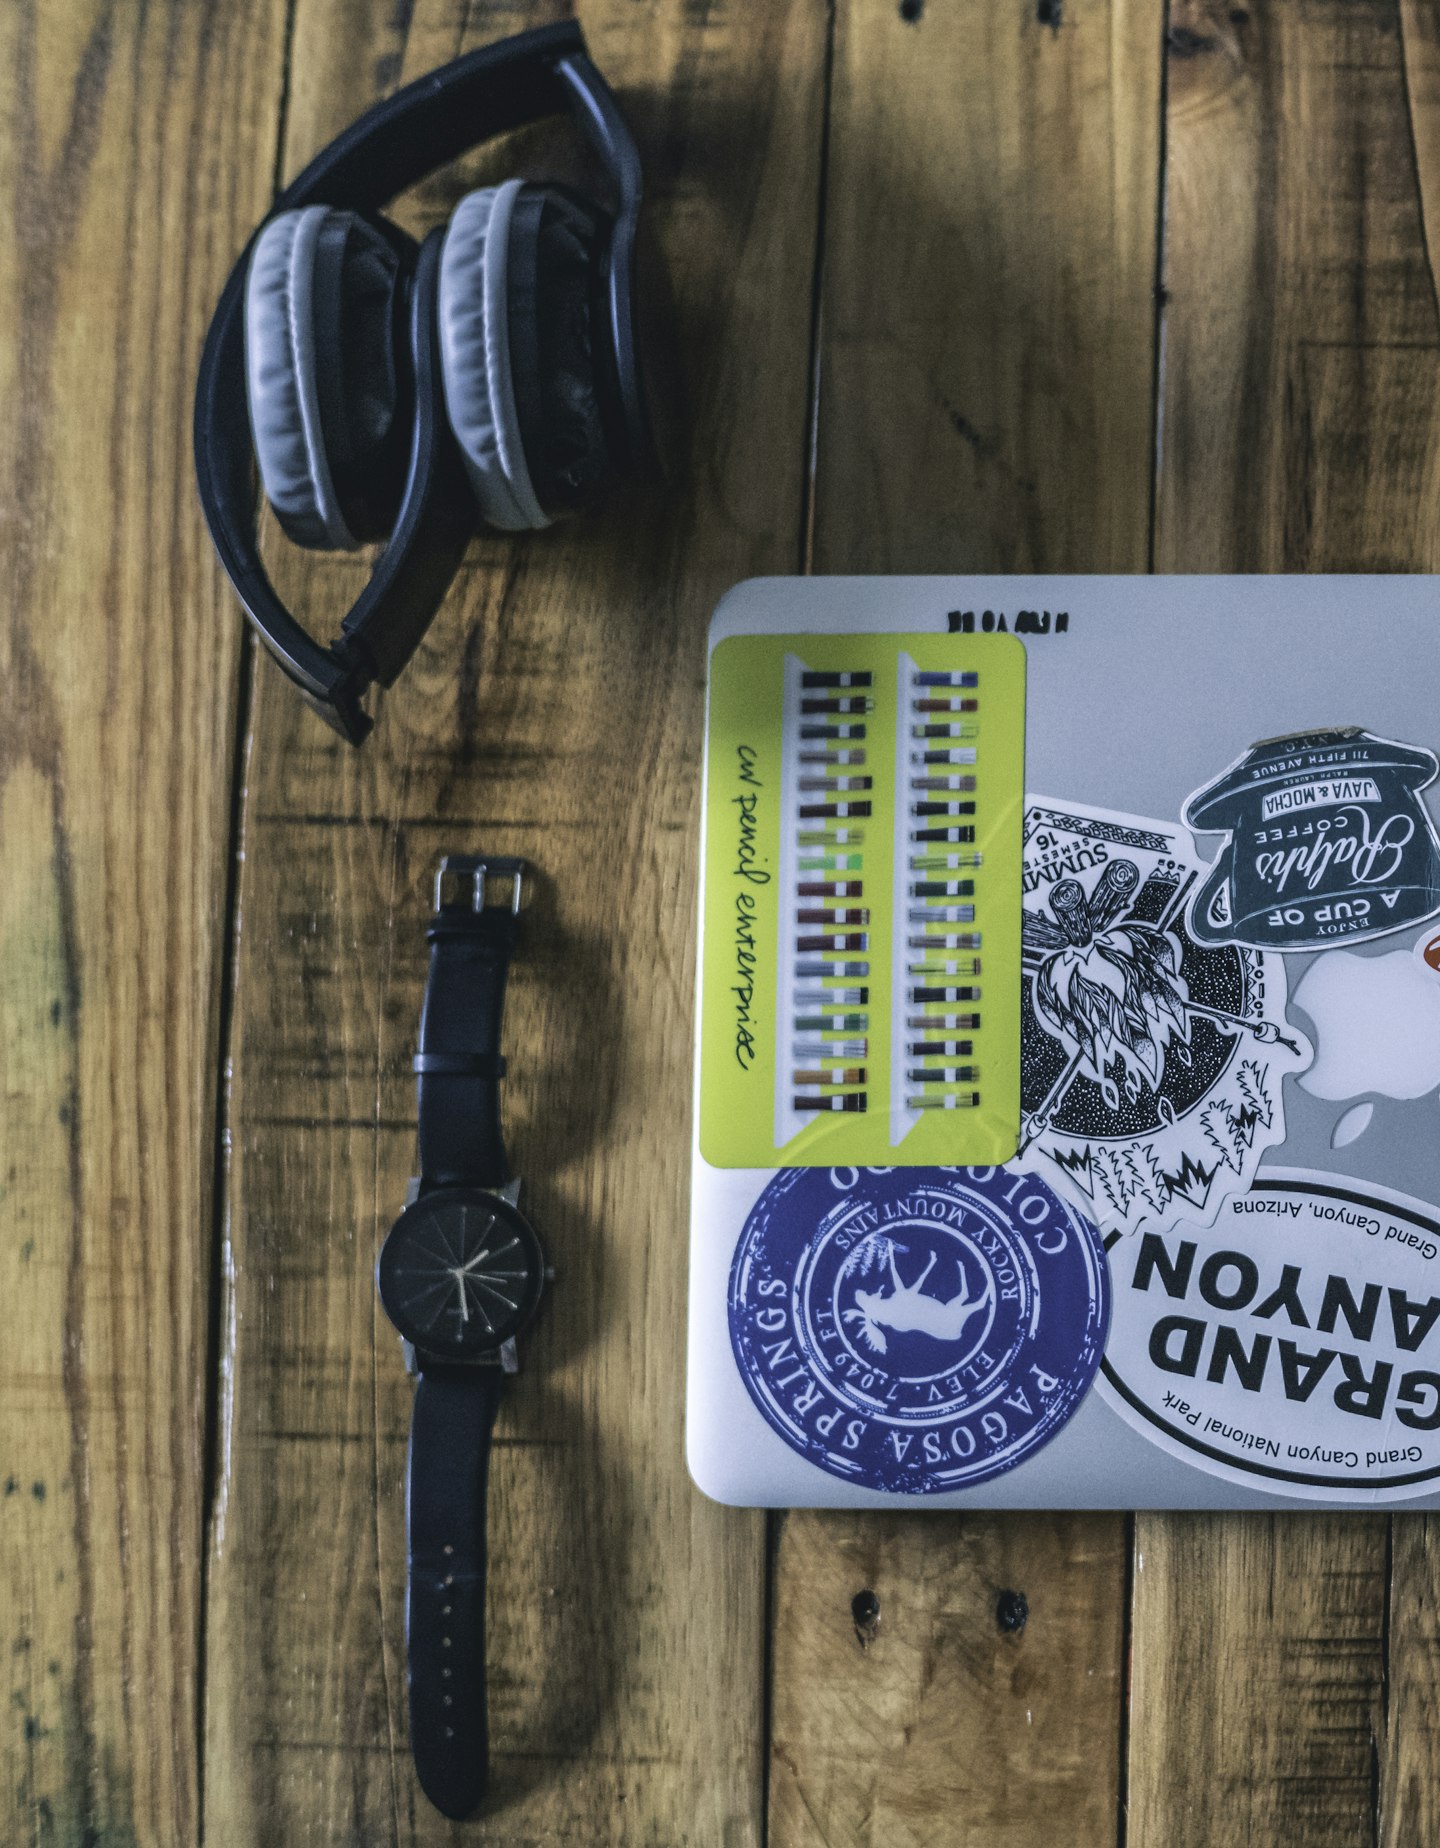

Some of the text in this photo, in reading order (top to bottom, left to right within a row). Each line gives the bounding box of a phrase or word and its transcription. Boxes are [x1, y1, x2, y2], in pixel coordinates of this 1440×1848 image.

[1252, 750, 1368, 779] 711 FIFTH AVENUE
[1282, 770, 1348, 786] RALPH LAUREN
[1265, 781, 1372, 814] JAVA & MOCHA
[731, 794, 771, 885] pencil
[1023, 838, 1089, 870] SEMESTE
[1036, 832, 1059, 850] 16
[1254, 816, 1348, 844] COFFEE
[1255, 805, 1415, 893] Ralph's
[1022, 843, 1108, 895] SUMMI
[1267, 890, 1401, 926] A CUP OF
[1316, 917, 1369, 935] ENJOY
[731, 892, 756, 1071] enterprise
[835, 1198, 1018, 1300] ROCKY MOUNTAINS
[1233, 1200, 1438, 1260] Grand Canyon, Arizona
[756, 1277, 1059, 1463] PAGOSA SPRINGS
[916, 1350, 995, 1401] ELEV.
[1161, 1390, 1423, 1468] Grand Canyon National Park
